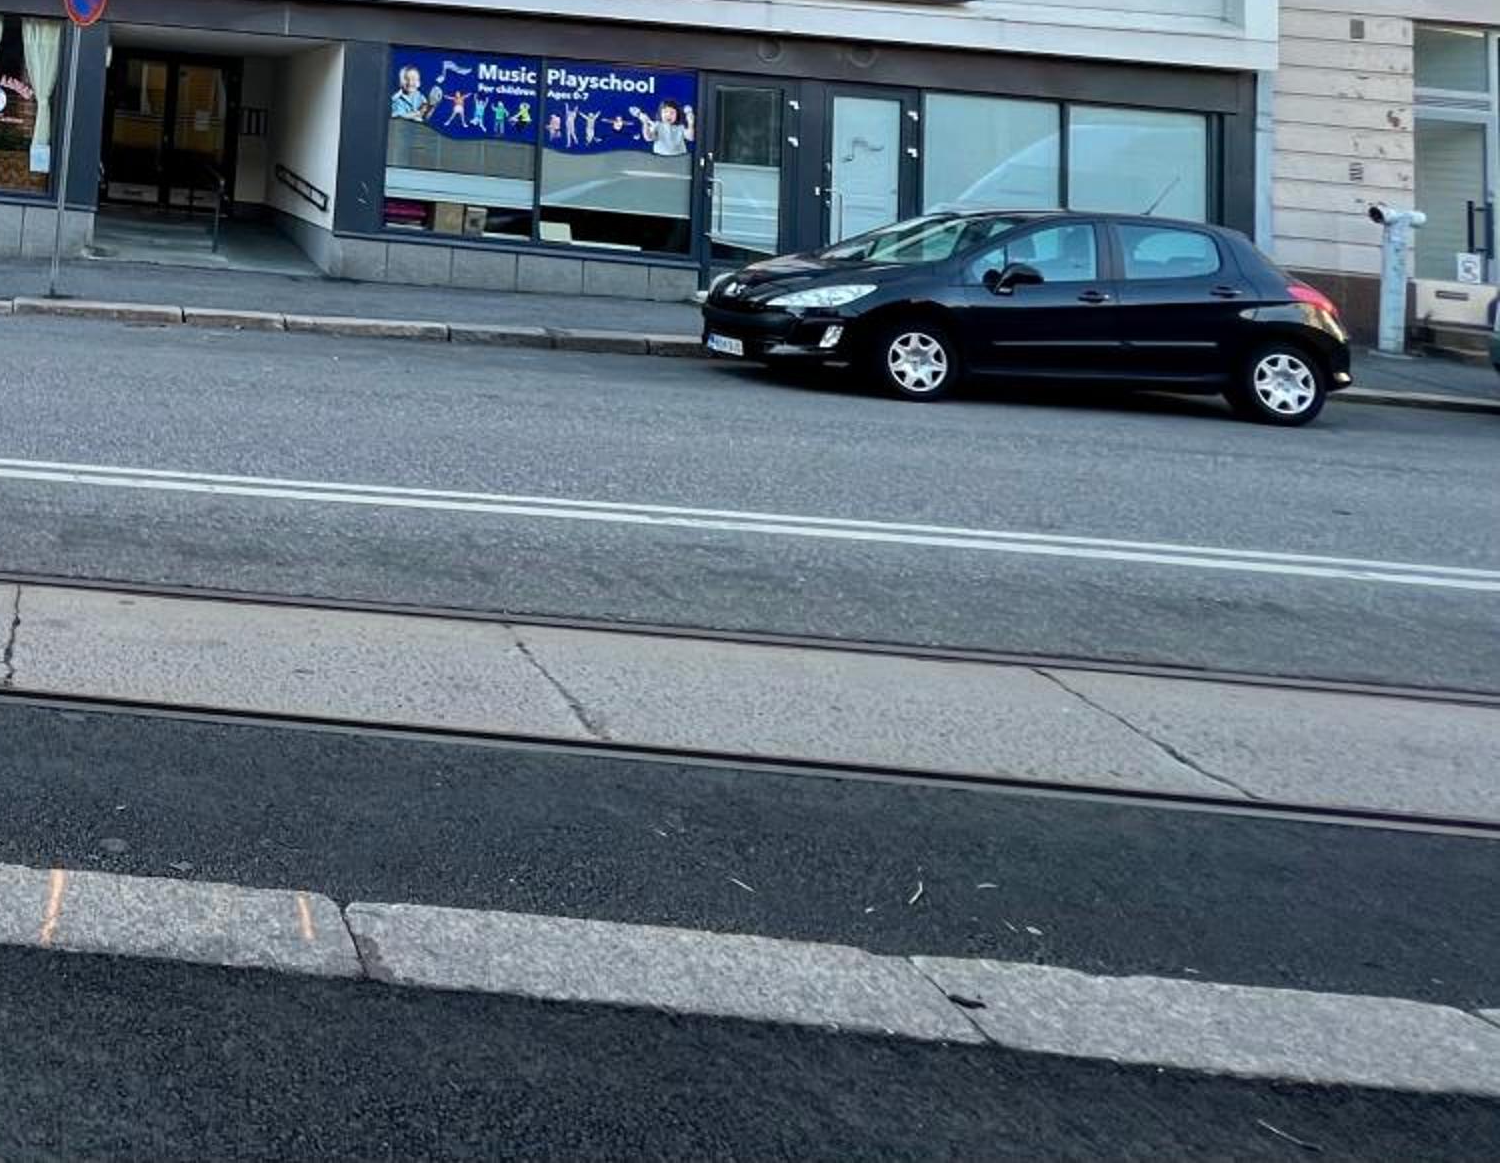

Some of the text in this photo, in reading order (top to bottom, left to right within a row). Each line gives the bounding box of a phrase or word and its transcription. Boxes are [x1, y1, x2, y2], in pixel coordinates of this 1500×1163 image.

[478, 63, 655, 94] Music Playschool
[477, 83, 494, 93] For
[496, 84, 537, 96] children
[547, 90, 571, 101] Ages
